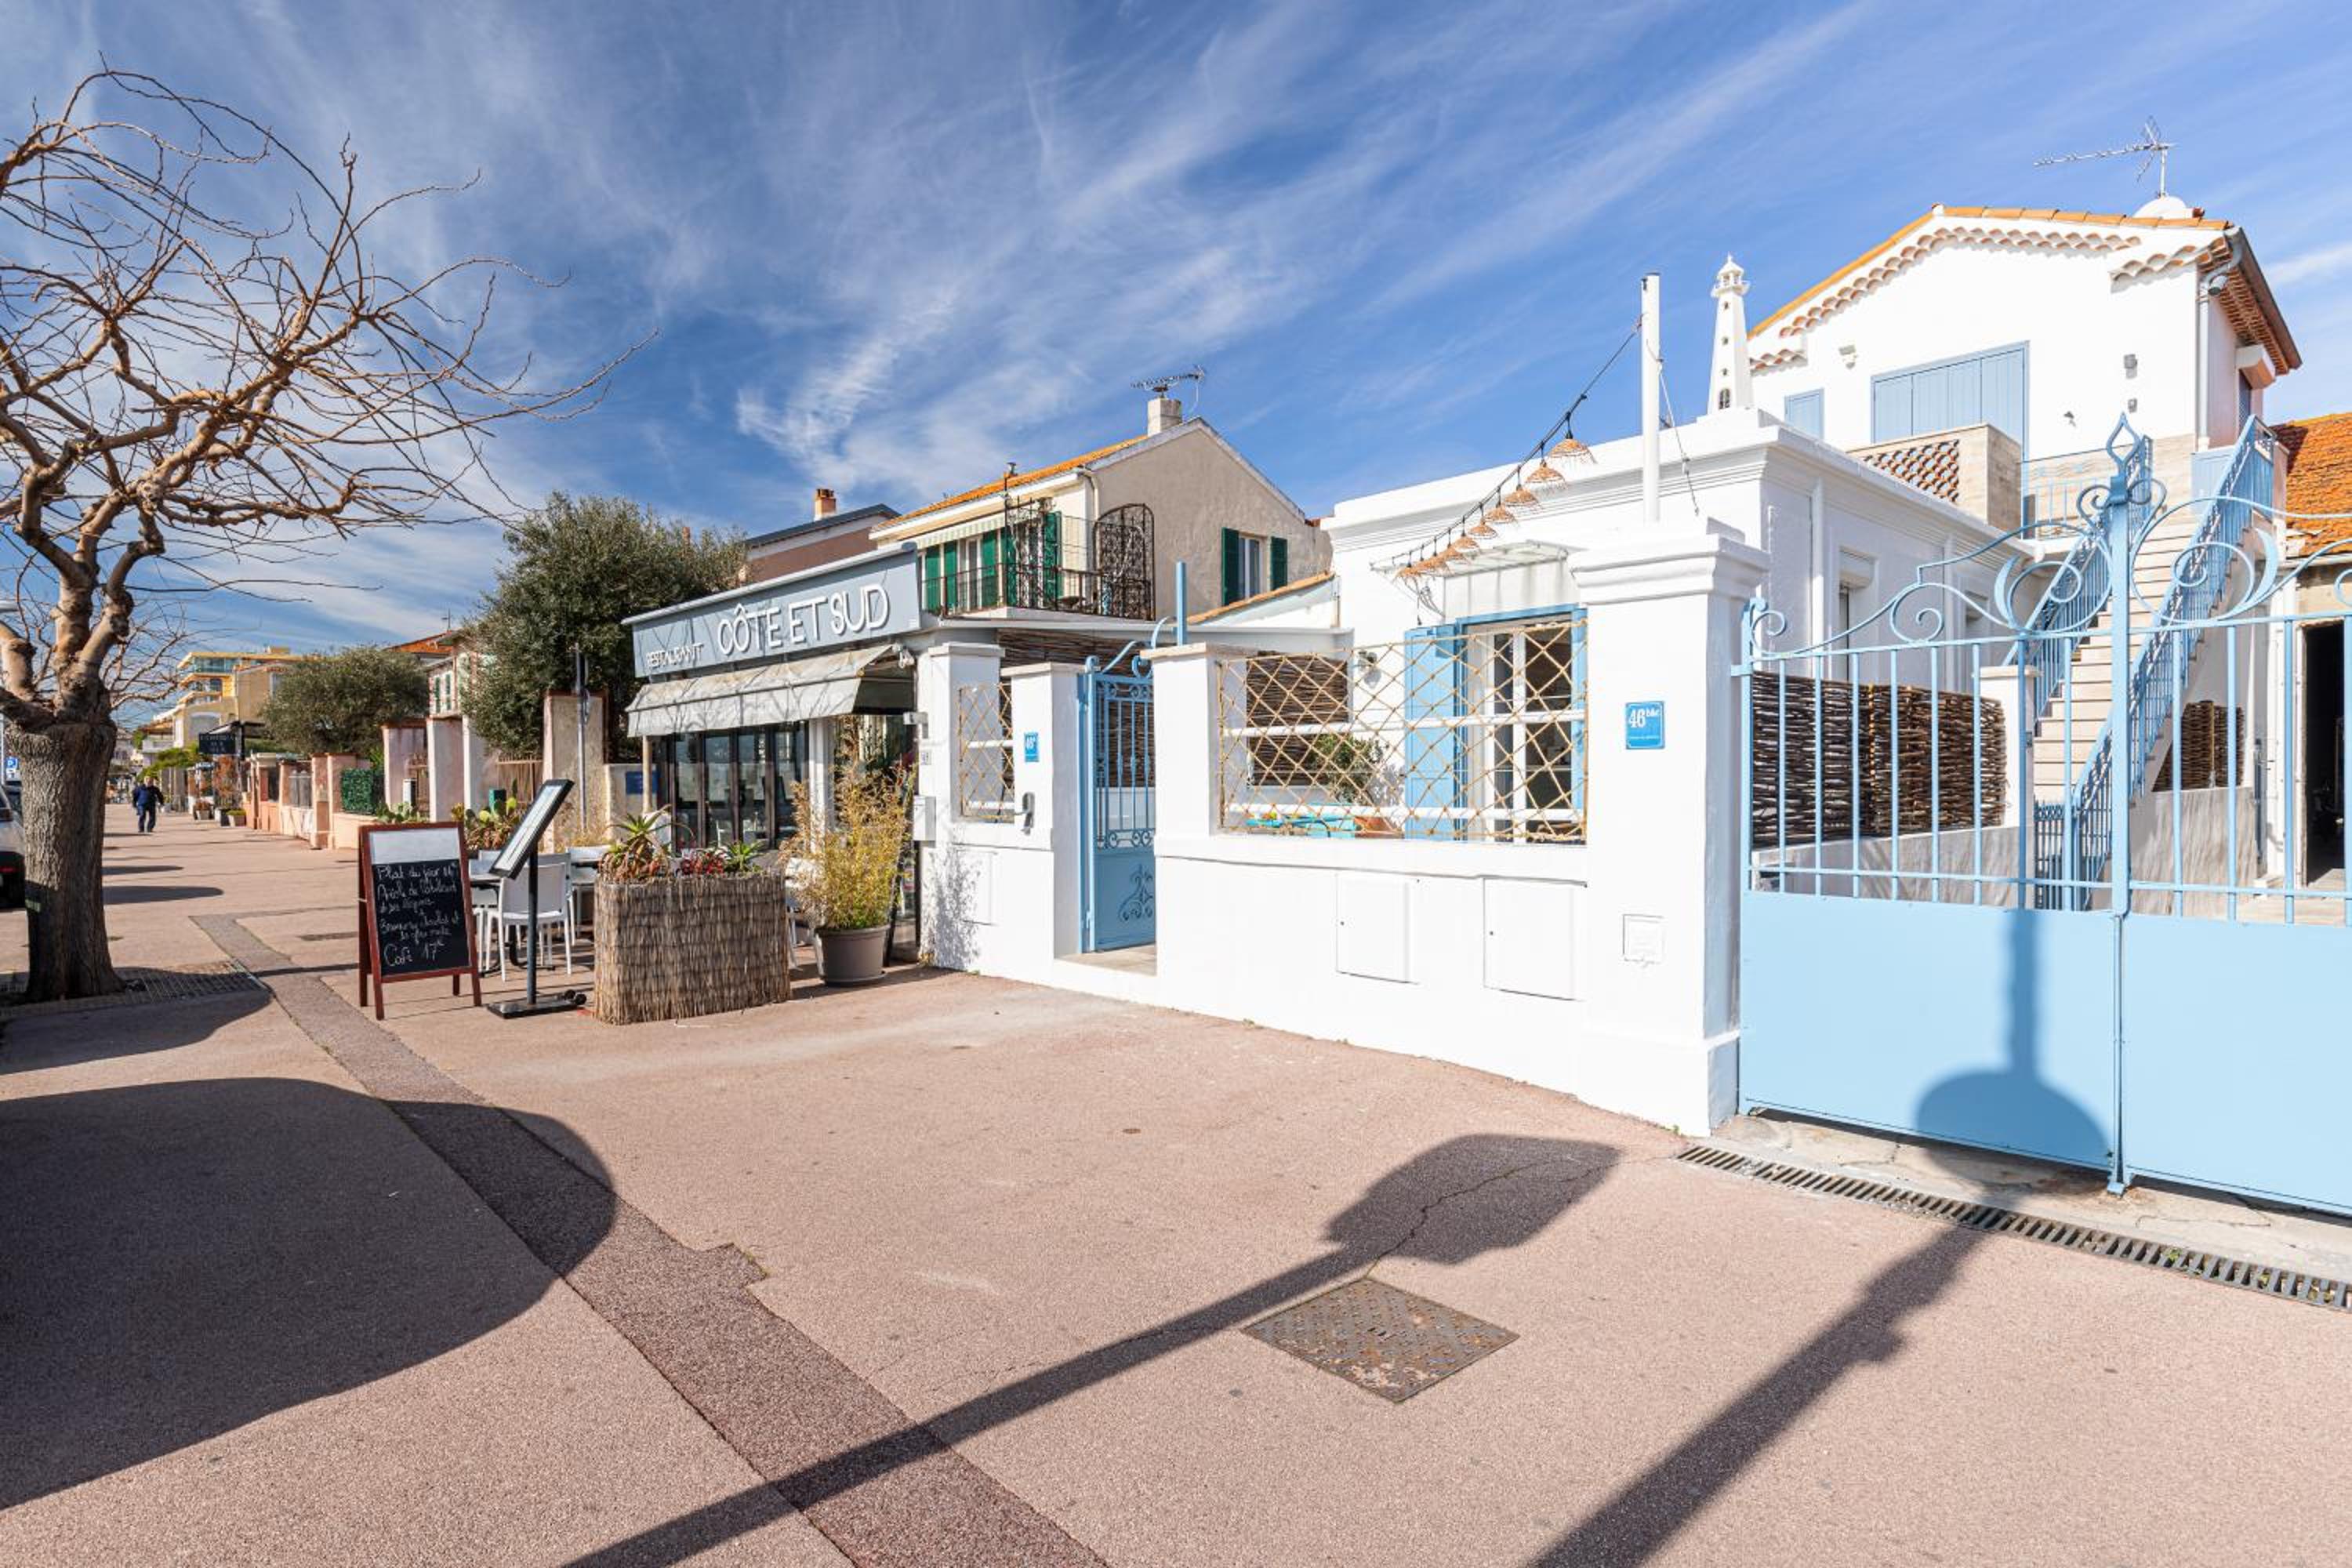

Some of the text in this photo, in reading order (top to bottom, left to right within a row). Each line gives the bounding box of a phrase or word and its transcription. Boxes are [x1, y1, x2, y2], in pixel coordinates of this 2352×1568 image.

[717, 583, 890, 656] CÔTE ET SUD
[646, 642, 704, 668] RESTAURANT
[376, 865, 404, 880] Plat
